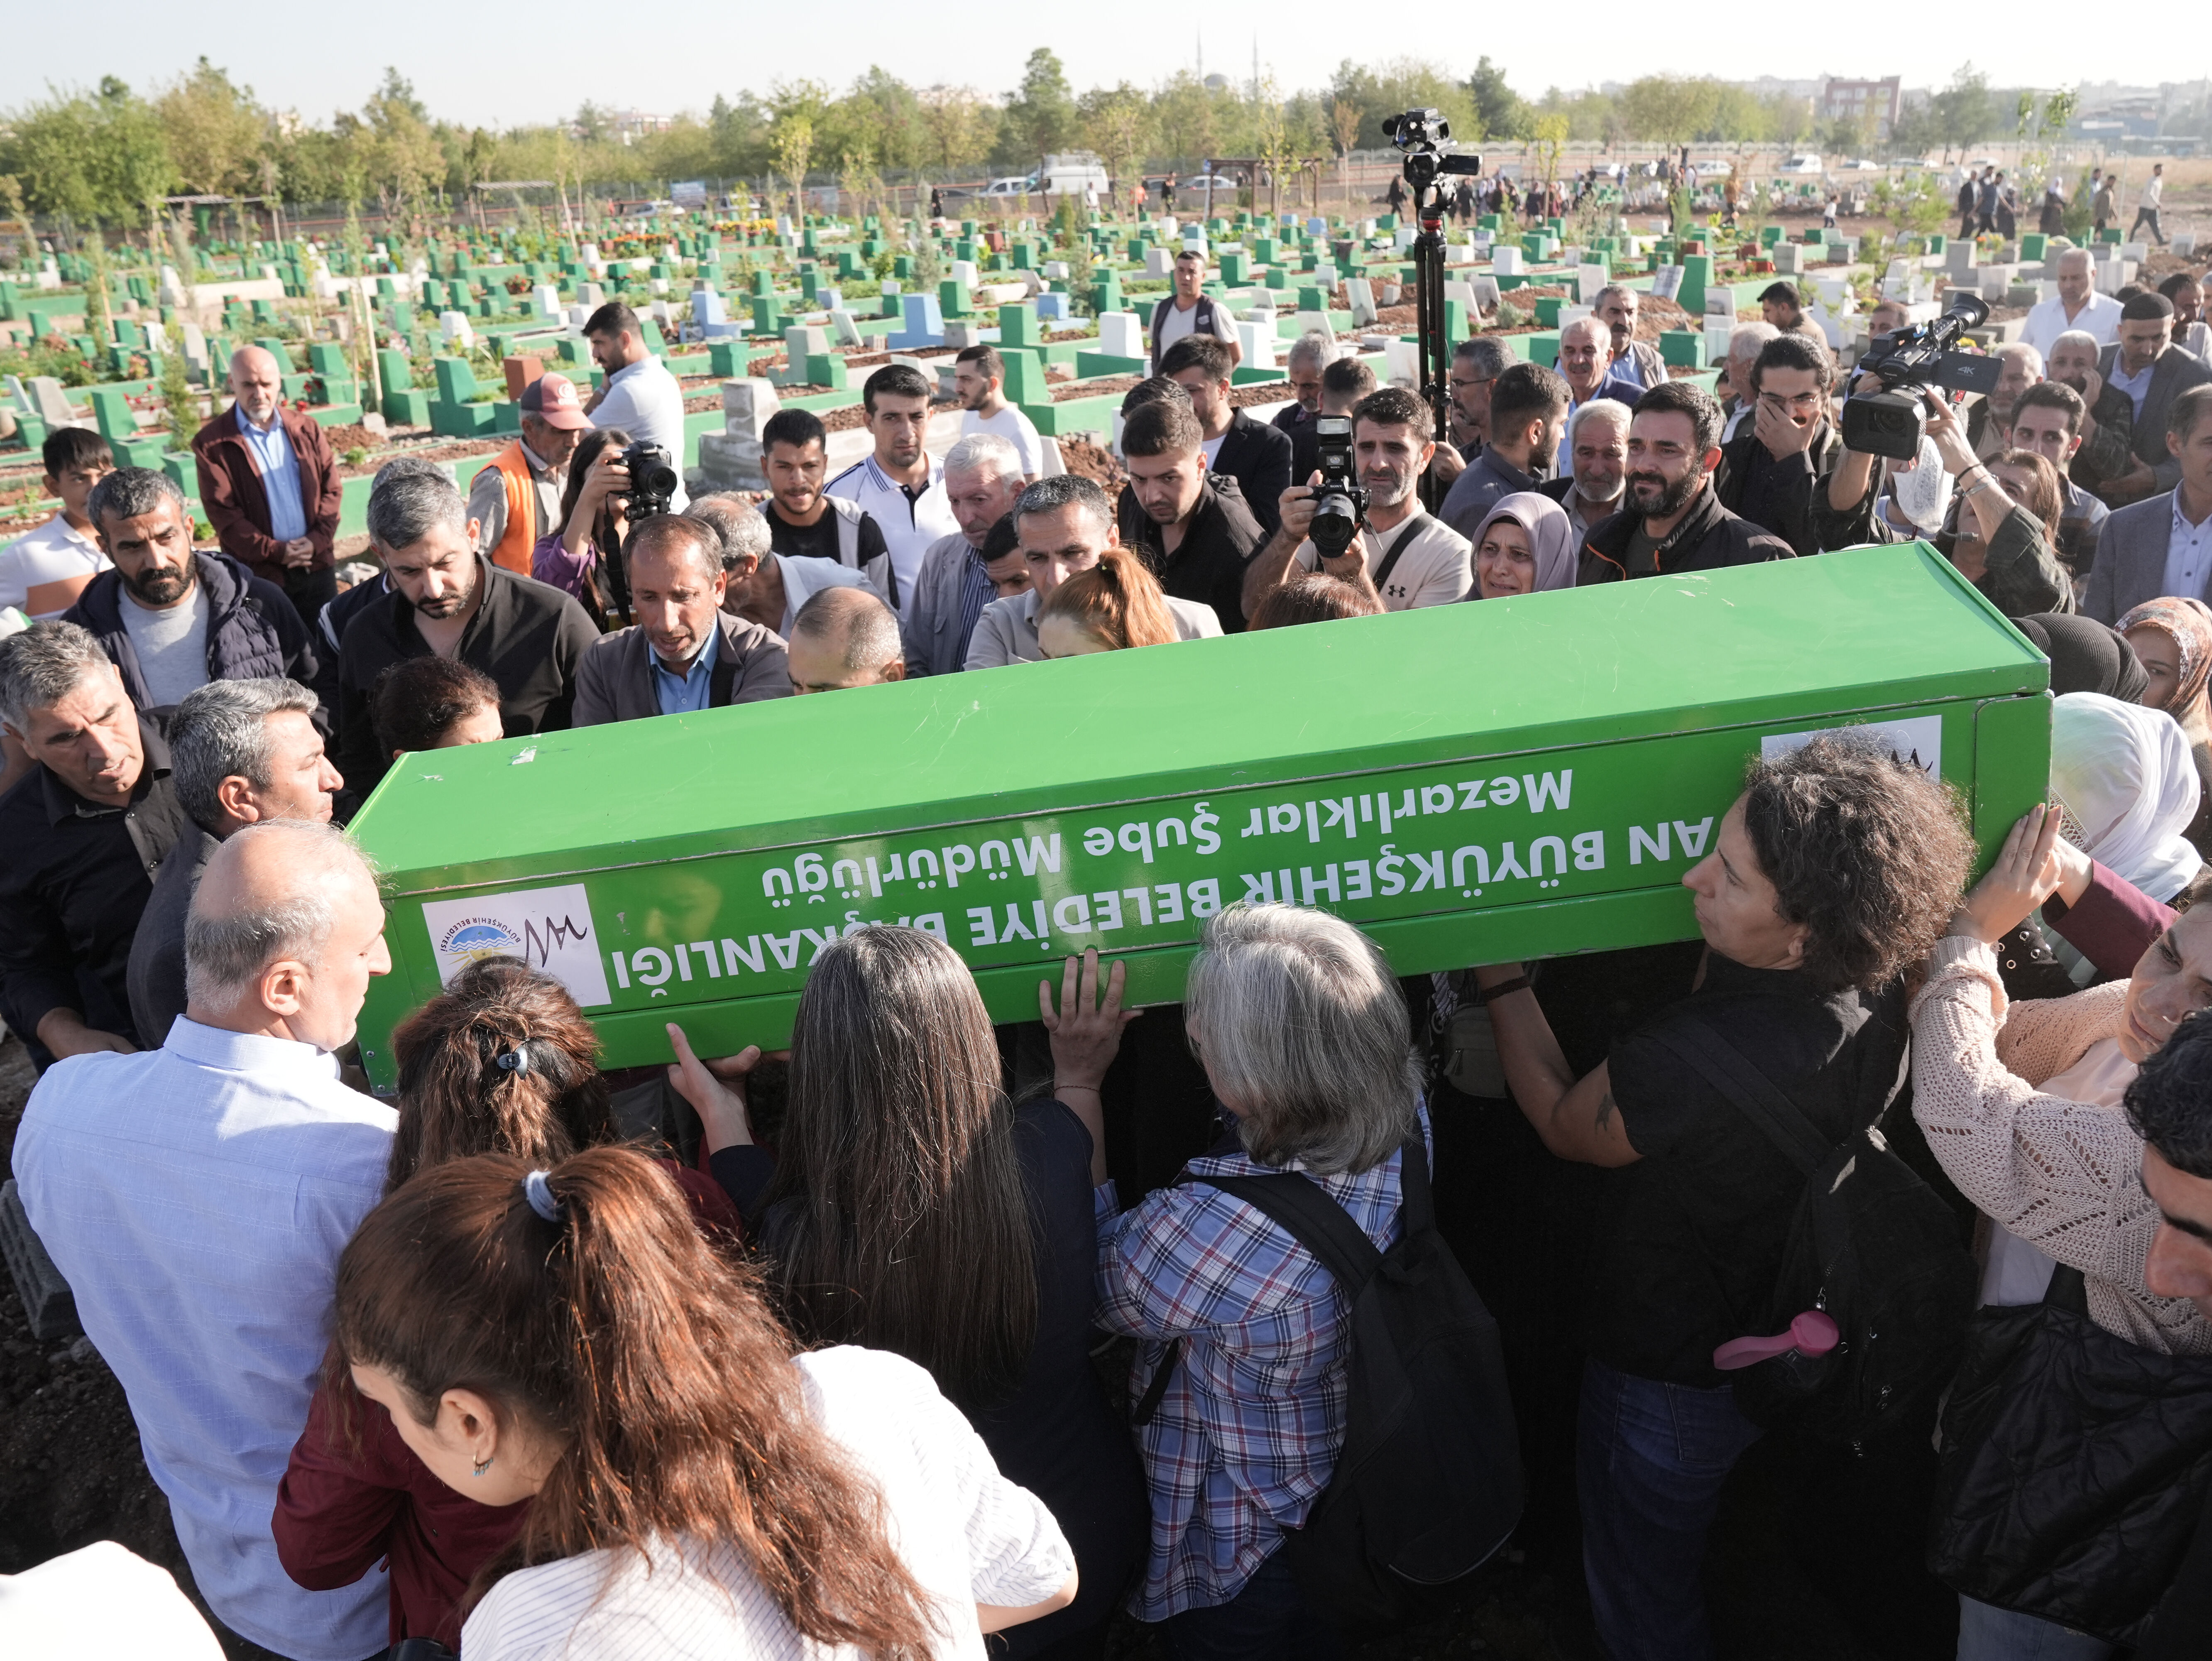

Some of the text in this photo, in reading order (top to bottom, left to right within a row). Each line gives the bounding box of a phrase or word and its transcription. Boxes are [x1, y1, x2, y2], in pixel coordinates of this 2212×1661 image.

[1958, 366, 1975, 375] 4K
[762, 769, 1572, 907] Mezarlıklar Şube Müdürlüğü
[1629, 817, 1715, 865] AN
[440, 917, 521, 952] BÜYÜKŞEHİR BELEDİYESİ
[967, 877, 1222, 953] BELEDİYE
